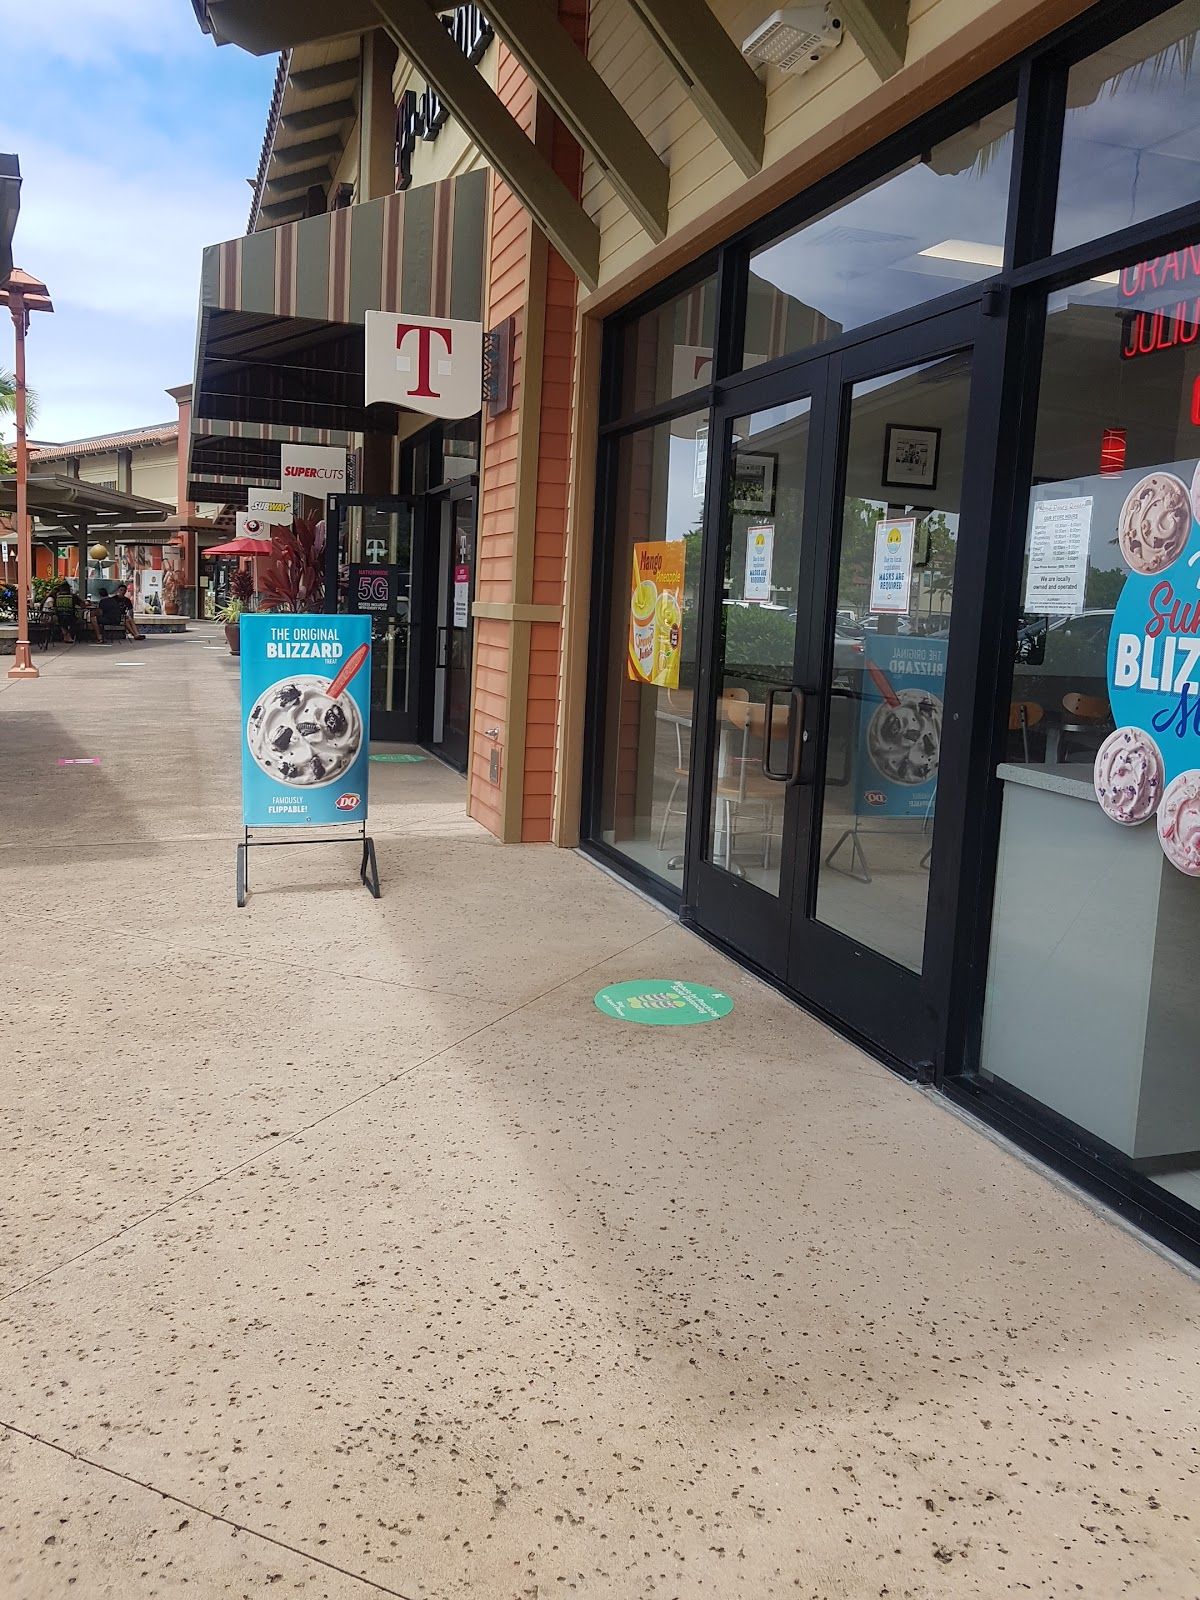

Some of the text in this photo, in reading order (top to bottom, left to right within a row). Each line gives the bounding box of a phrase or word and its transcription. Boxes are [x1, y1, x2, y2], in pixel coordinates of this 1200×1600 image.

[397, 324, 452, 398] T
[284, 466, 344, 479] SUPERCUTS
[251, 501, 291, 512] SUBWAY
[640, 550, 663, 575] Mango
[879, 572, 904, 581] MASKS ARE
[358, 577, 389, 601] 5G
[880, 582, 902, 590] REQUIRED
[271, 628, 339, 640] THE ORIGINAL
[266, 642, 343, 658] BLIZZARD
[272, 796, 303, 804] FAMOUSLY
[340, 797, 356, 807] DQ
[268, 805, 308, 813] FLIPPABLE!
